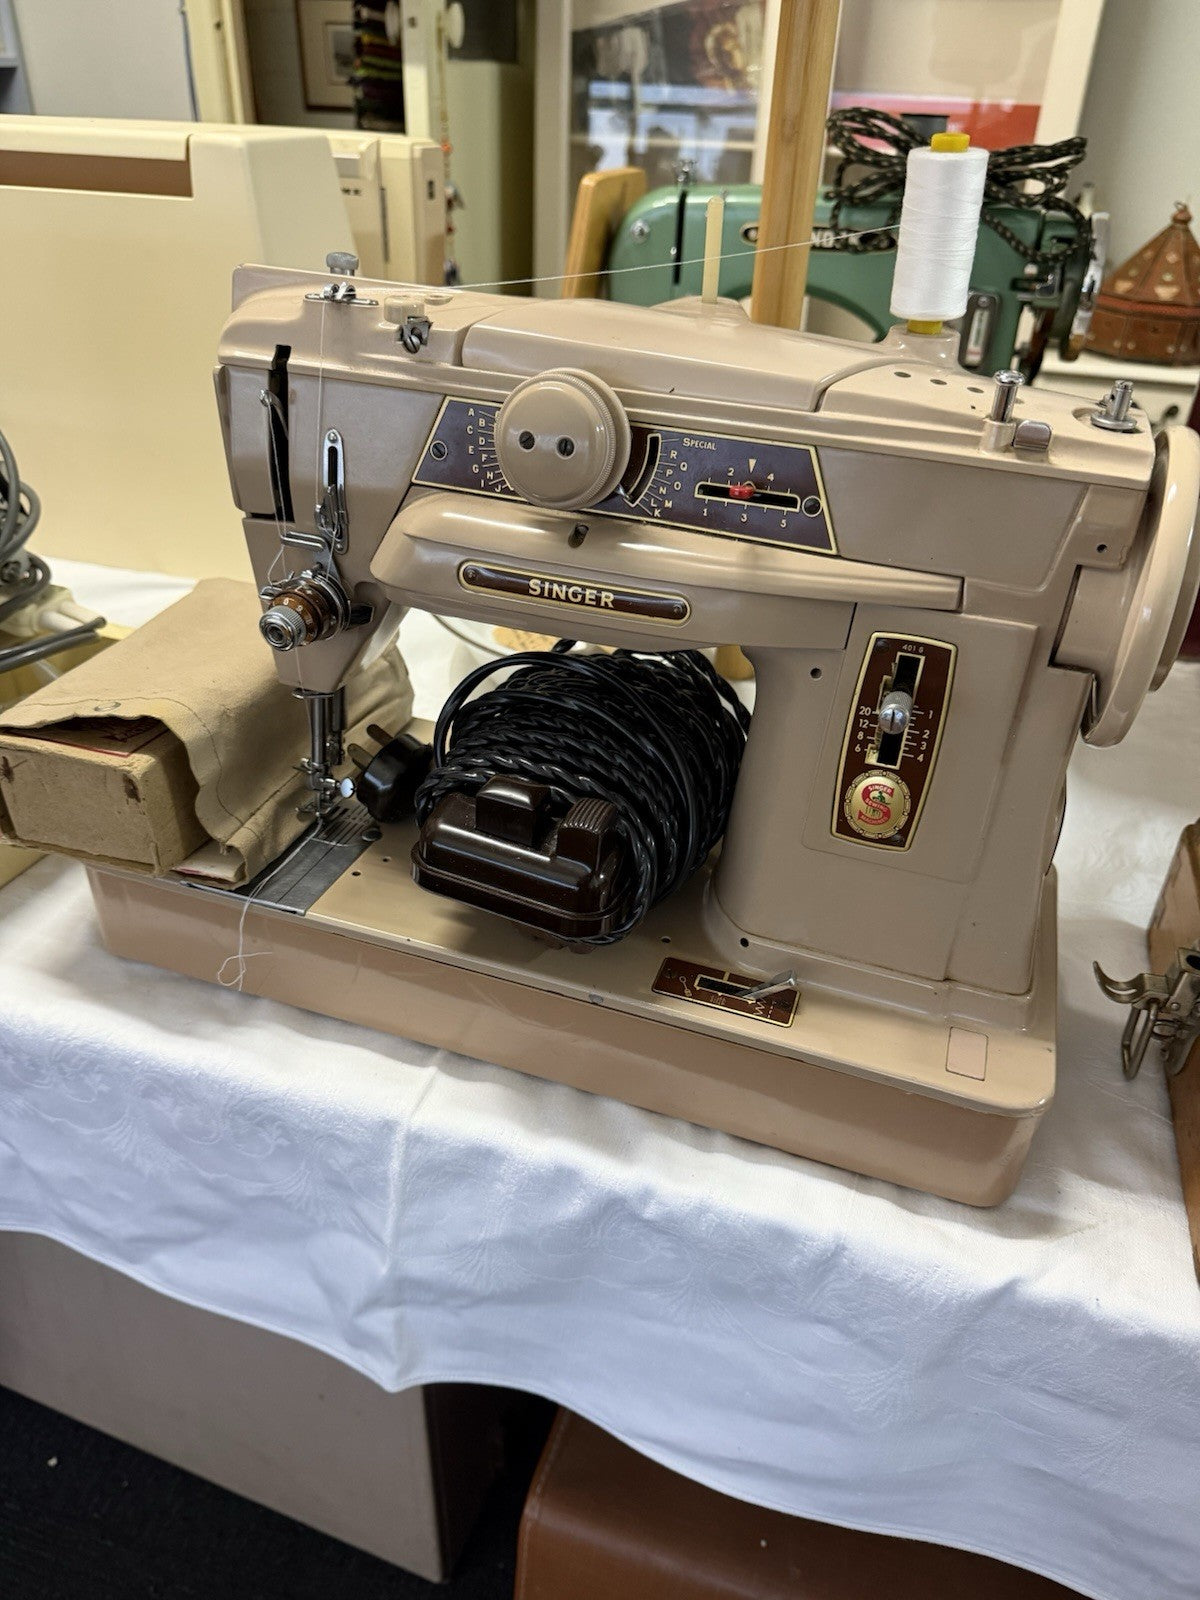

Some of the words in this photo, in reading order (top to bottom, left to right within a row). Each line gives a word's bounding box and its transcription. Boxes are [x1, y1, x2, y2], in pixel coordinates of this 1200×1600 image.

[468, 408, 475, 416] A
[479, 418, 486, 427] B
[467, 425, 474, 434] C
[479, 437, 486, 446] D
[468, 445, 475, 454] E
[669, 449, 678, 460] R
[481, 454, 488, 462] F
[472, 464, 479, 473] G
[680, 461, 688, 472] Q
[486, 471, 494, 480] H
[665, 468, 673, 478] P
[727, 467, 735, 477] 2
[766, 473, 775, 483] 4
[495, 484, 502, 492] J
[659, 486, 667, 495] N
[673, 481, 682, 491] O
[650, 498, 658, 508] L
[664, 500, 673, 509] M
[653, 509, 661, 518] K
[702, 508, 708, 517] 1
[740, 513, 748, 523] 3
[780, 519, 787, 529] 5
[528, 579, 614, 608] SINGER
[902, 643, 917, 652] 401
[859, 706, 872, 717] 20
[928, 709, 934, 720] 1
[859, 718, 870, 729] 12
[856, 731, 865, 741] 8
[921, 729, 931, 740] 2
[854, 744, 862, 753] 6
[919, 741, 928, 751] 3
[916, 753, 925, 763] 4
